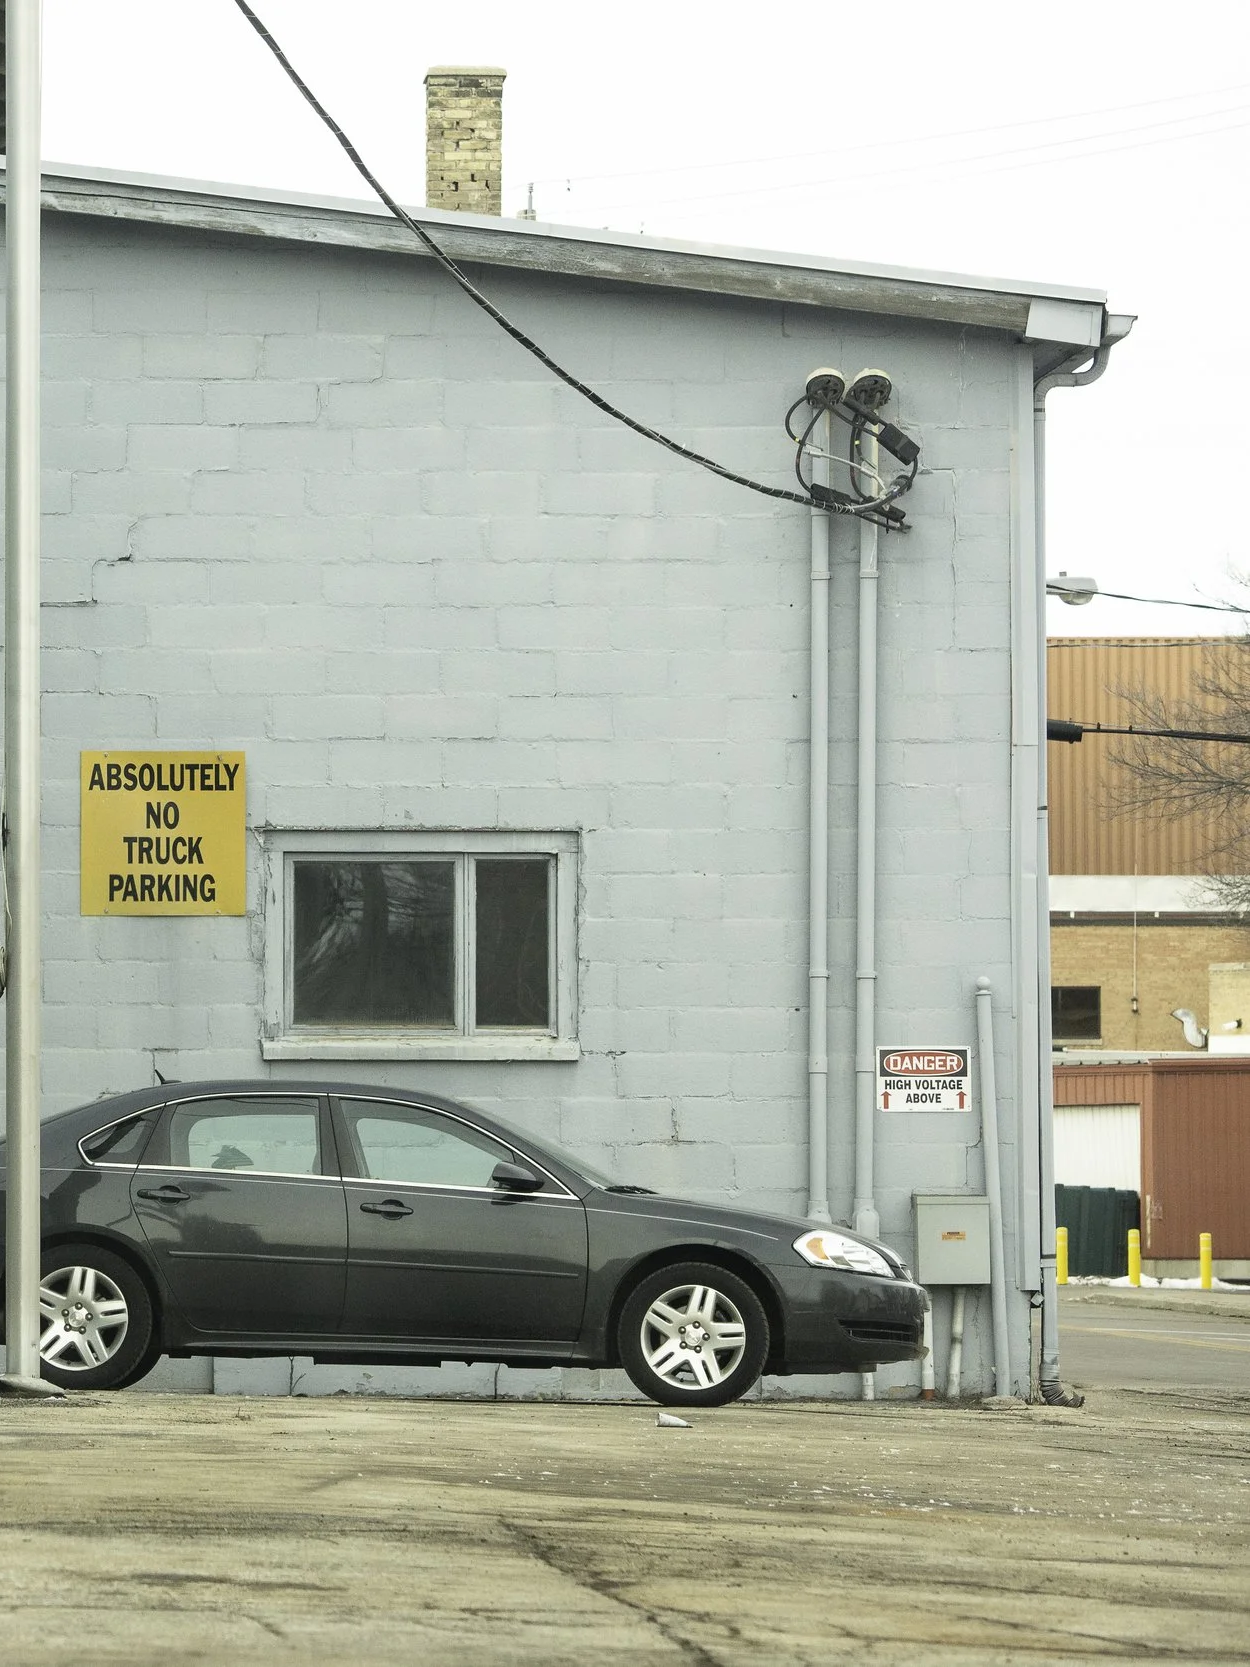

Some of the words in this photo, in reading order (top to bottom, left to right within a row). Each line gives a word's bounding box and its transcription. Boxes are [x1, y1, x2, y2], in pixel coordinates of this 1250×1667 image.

[88, 763, 240, 792] ABSOLUTELY
[146, 801, 180, 830] NO
[123, 836, 204, 865] TRUCK
[108, 873, 216, 902] PARKING
[889, 1056, 958, 1071] DANGER
[884, 1079, 911, 1090] HIGH
[914, 1079, 963, 1090] VOLTAGE
[905, 1093, 942, 1104] ABOVE
